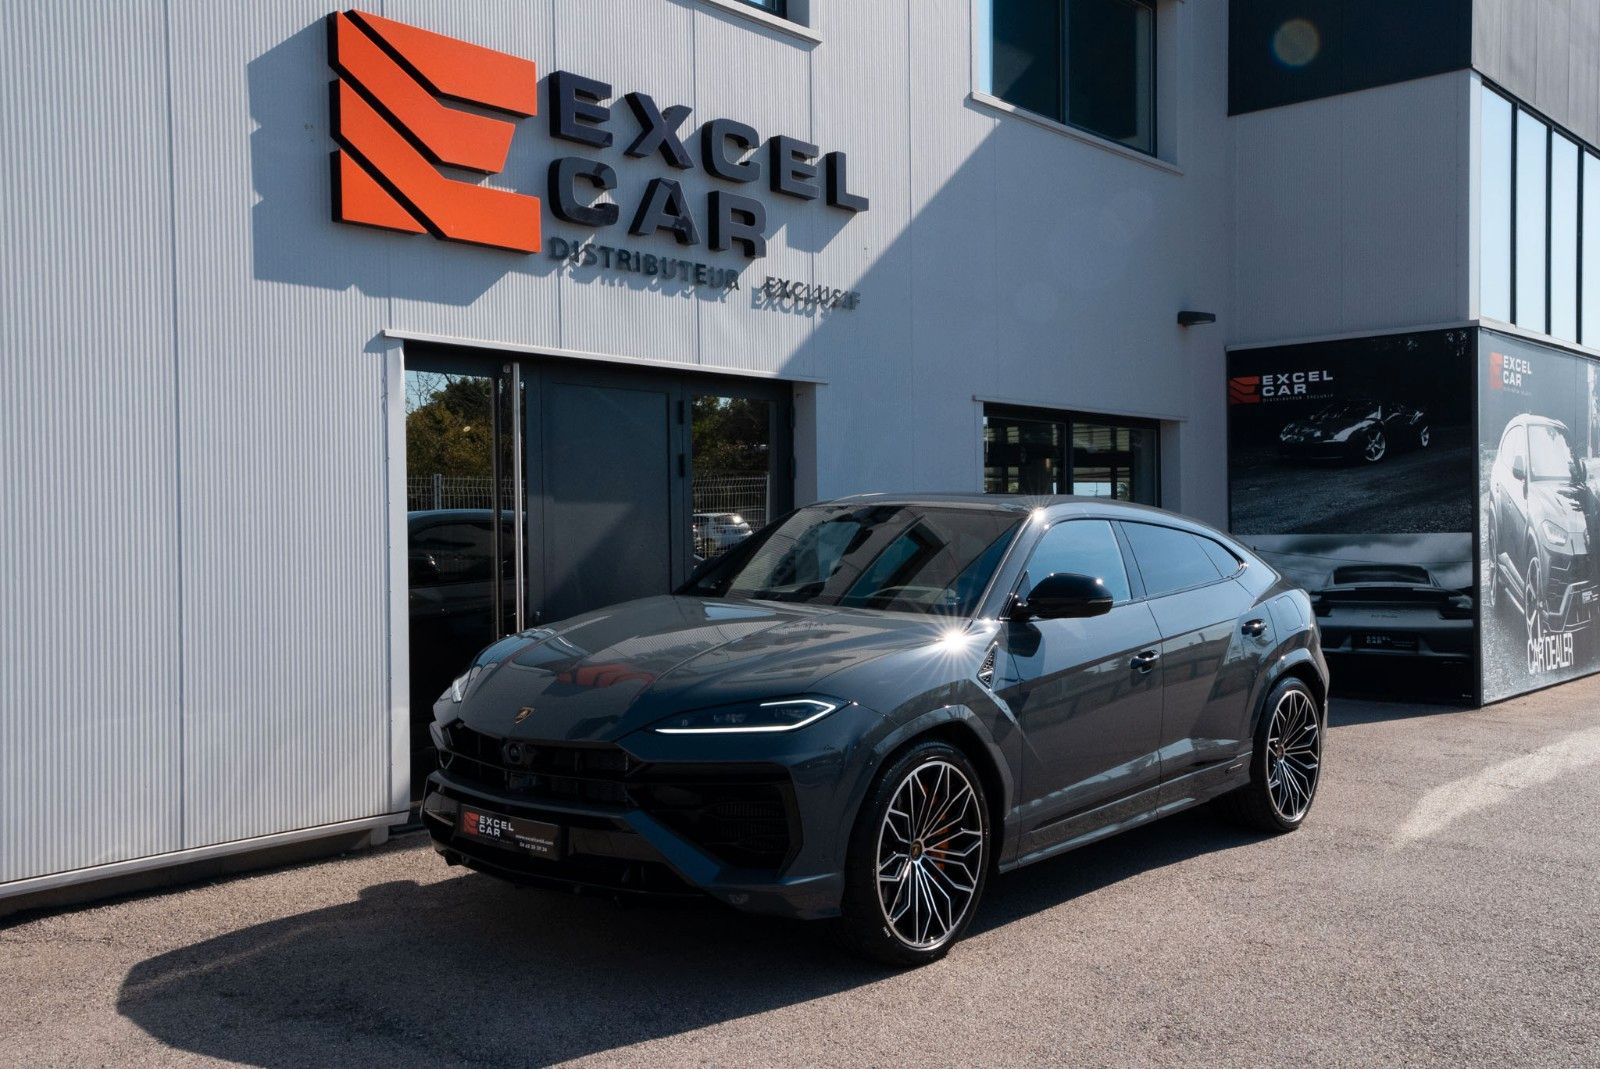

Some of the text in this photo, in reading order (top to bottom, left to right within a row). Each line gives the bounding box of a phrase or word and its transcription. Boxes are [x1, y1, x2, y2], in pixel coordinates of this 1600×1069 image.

[549, 70, 869, 212] EXCEL
[548, 157, 767, 259] CAR
[549, 237, 740, 291] DISTRIBUTEUR
[1503, 355, 1532, 375] EXCEL
[1262, 370, 1334, 386] EXCEL
[1502, 371, 1522, 387] CAR
[1262, 384, 1307, 397] CAR
[1527, 632, 1574, 674] CAR DEALER
[479, 815, 515, 832] EXCEL
[479, 824, 501, 837] CAR
